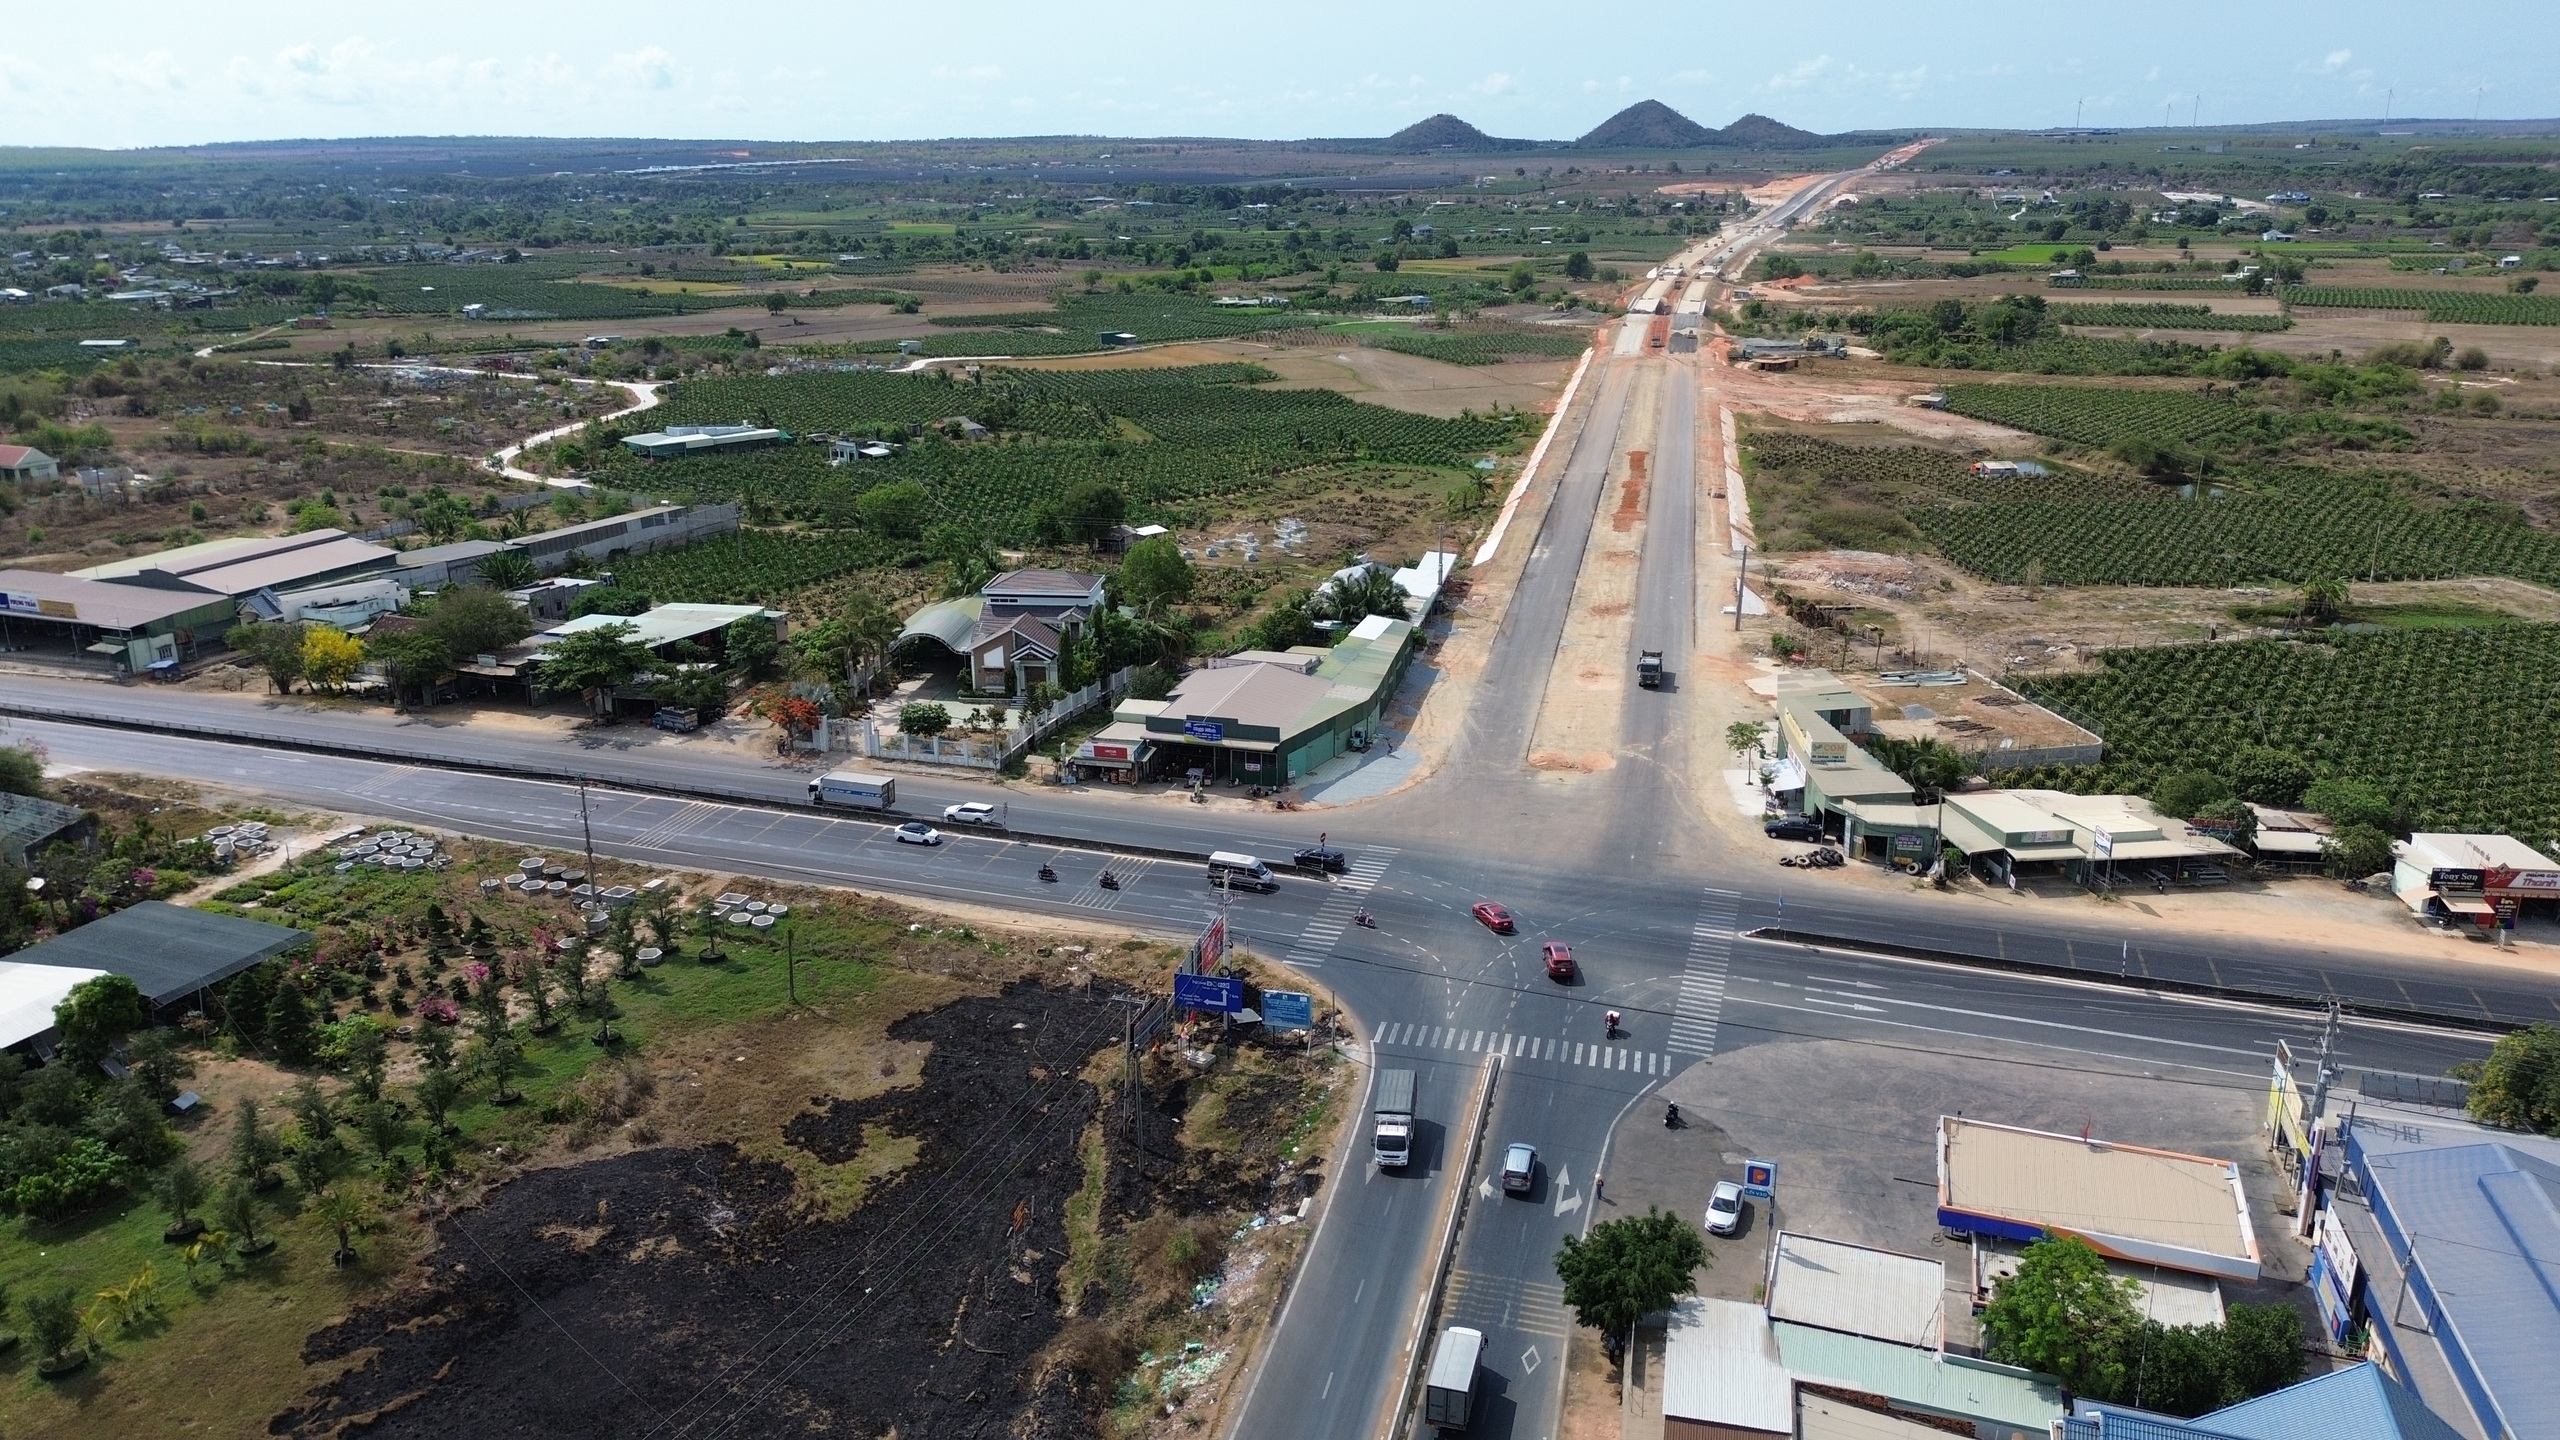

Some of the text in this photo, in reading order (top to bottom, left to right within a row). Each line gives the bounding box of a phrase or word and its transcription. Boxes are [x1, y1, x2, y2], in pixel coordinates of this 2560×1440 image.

[2439, 872, 2460, 881] Tony
[2460, 872, 2479, 881] Sơn
[2522, 878, 2557, 887] Thanh
